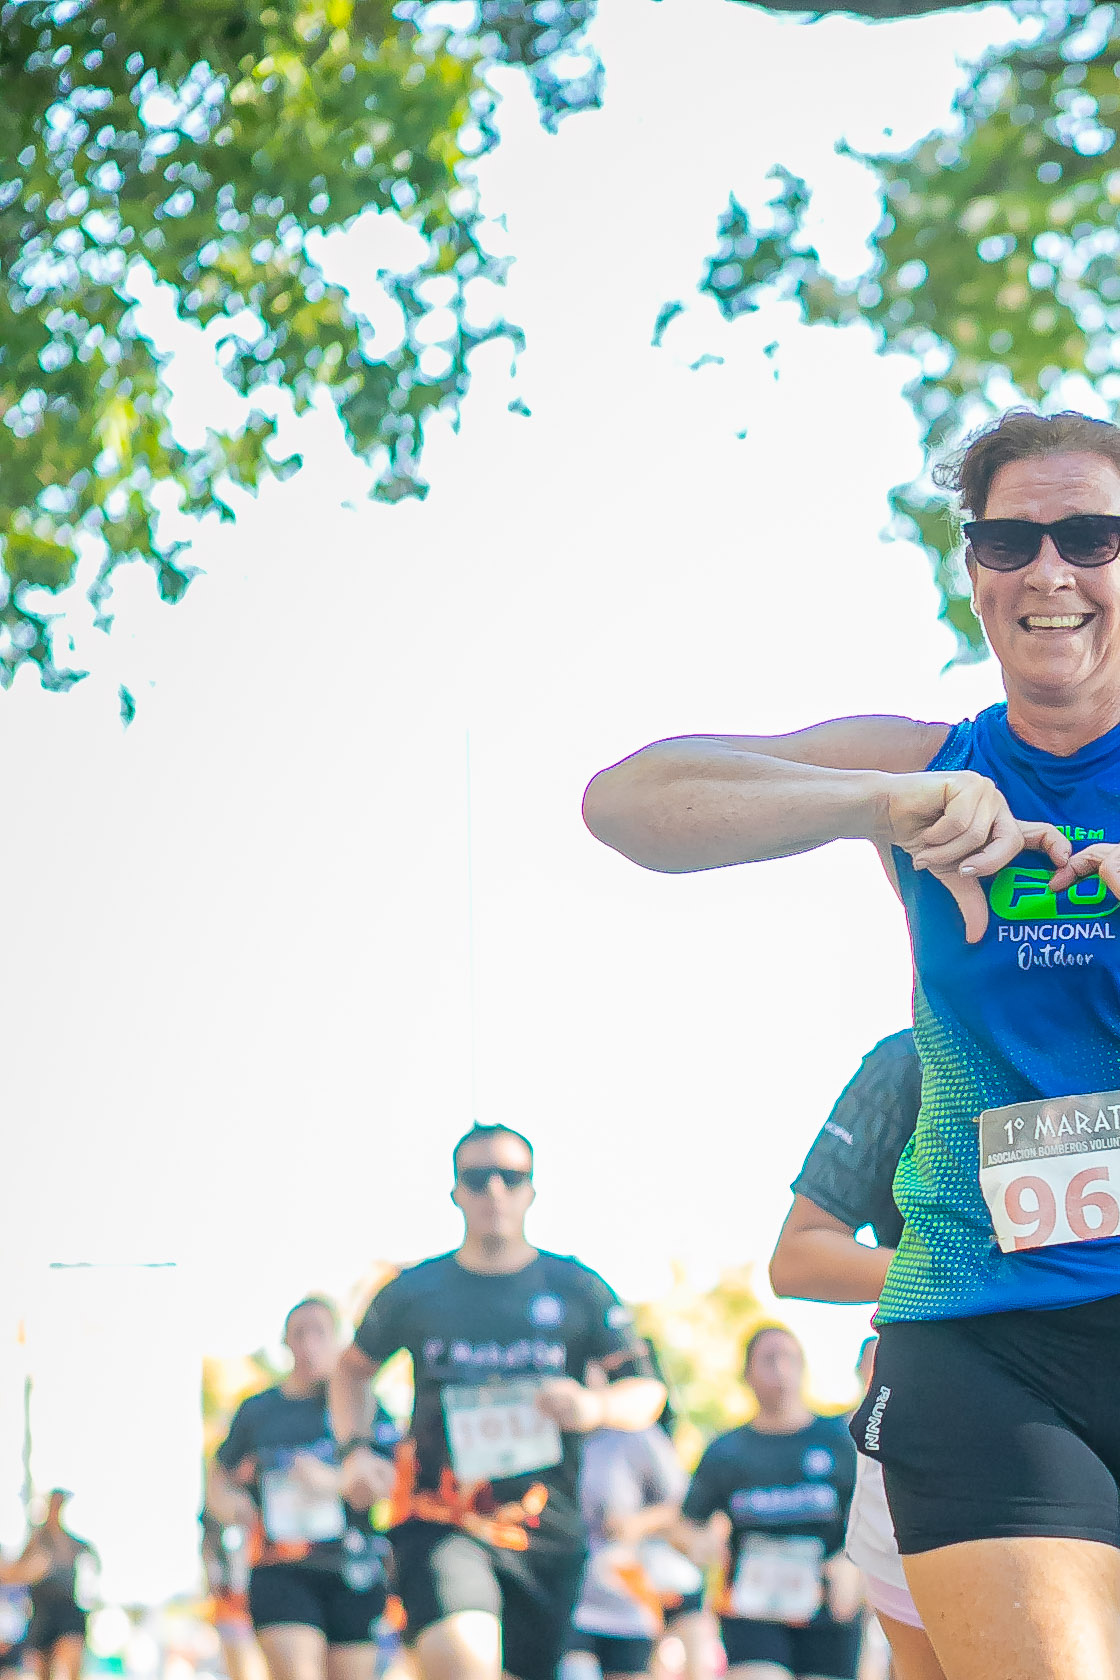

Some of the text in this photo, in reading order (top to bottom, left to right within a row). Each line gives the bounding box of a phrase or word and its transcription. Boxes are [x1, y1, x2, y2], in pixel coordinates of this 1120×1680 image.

[998, 922, 1116, 942] FUNCIONAL
[1017, 942, 1094, 971] Outdoor
[1038, 1140, 1089, 1158] BOMBEROS
